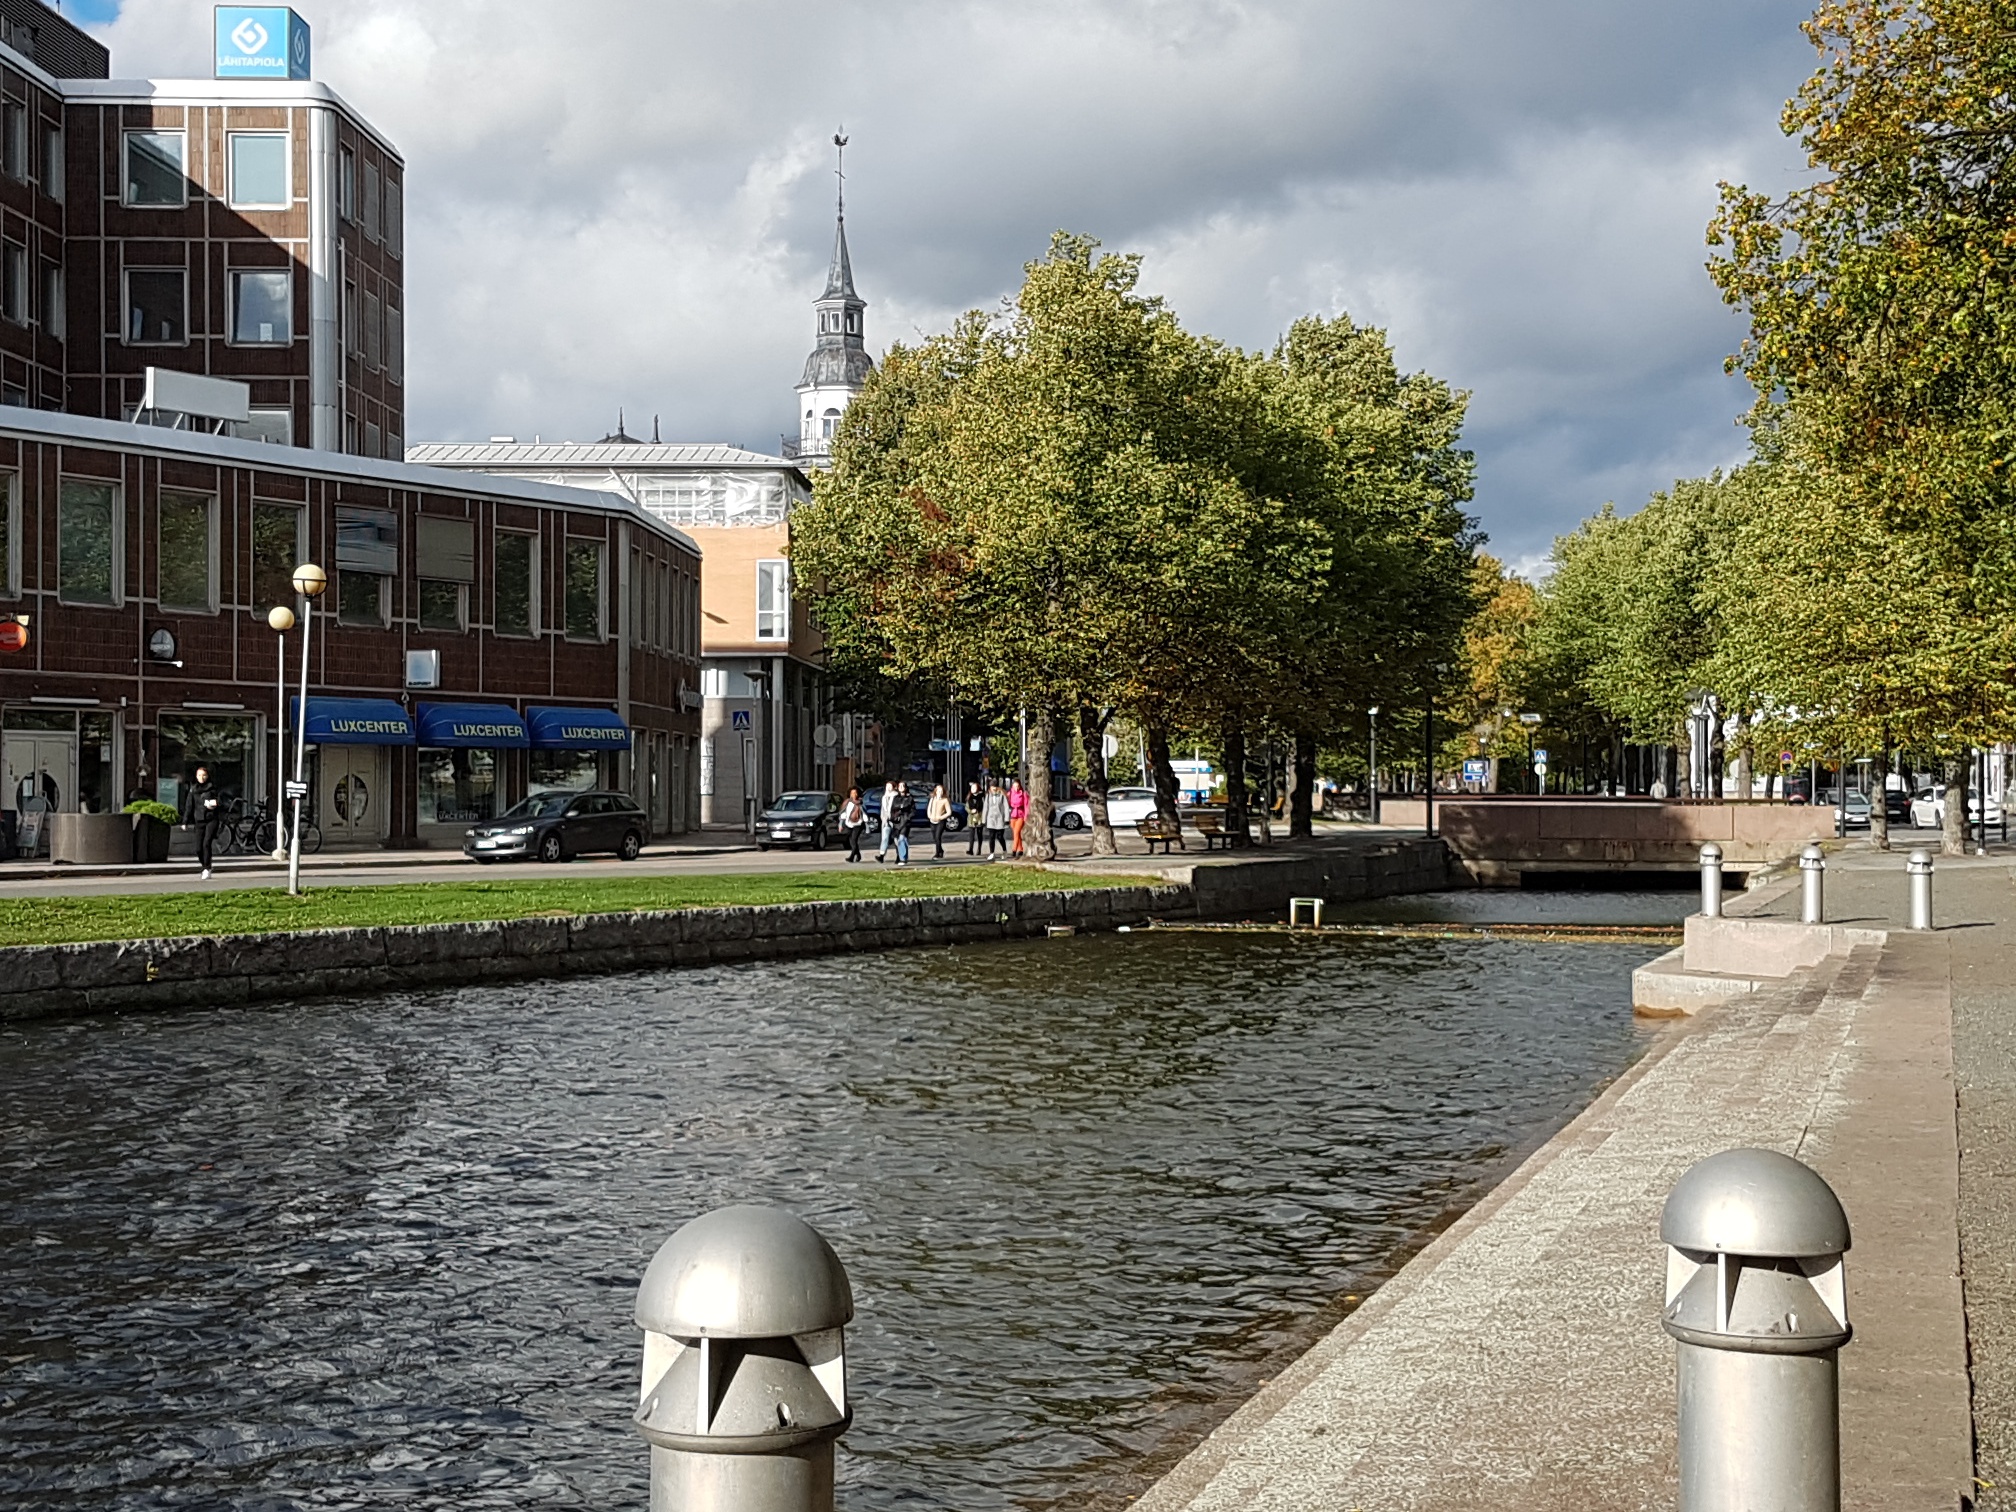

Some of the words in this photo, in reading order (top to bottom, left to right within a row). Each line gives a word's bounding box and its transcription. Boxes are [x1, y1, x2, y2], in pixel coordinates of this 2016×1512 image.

[218, 55, 285, 67] LÄHITAPIOLA
[330, 719, 408, 734] LUXCENTER
[453, 723, 524, 738] LUXCENTER
[561, 726, 626, 740] LUXCENTER
